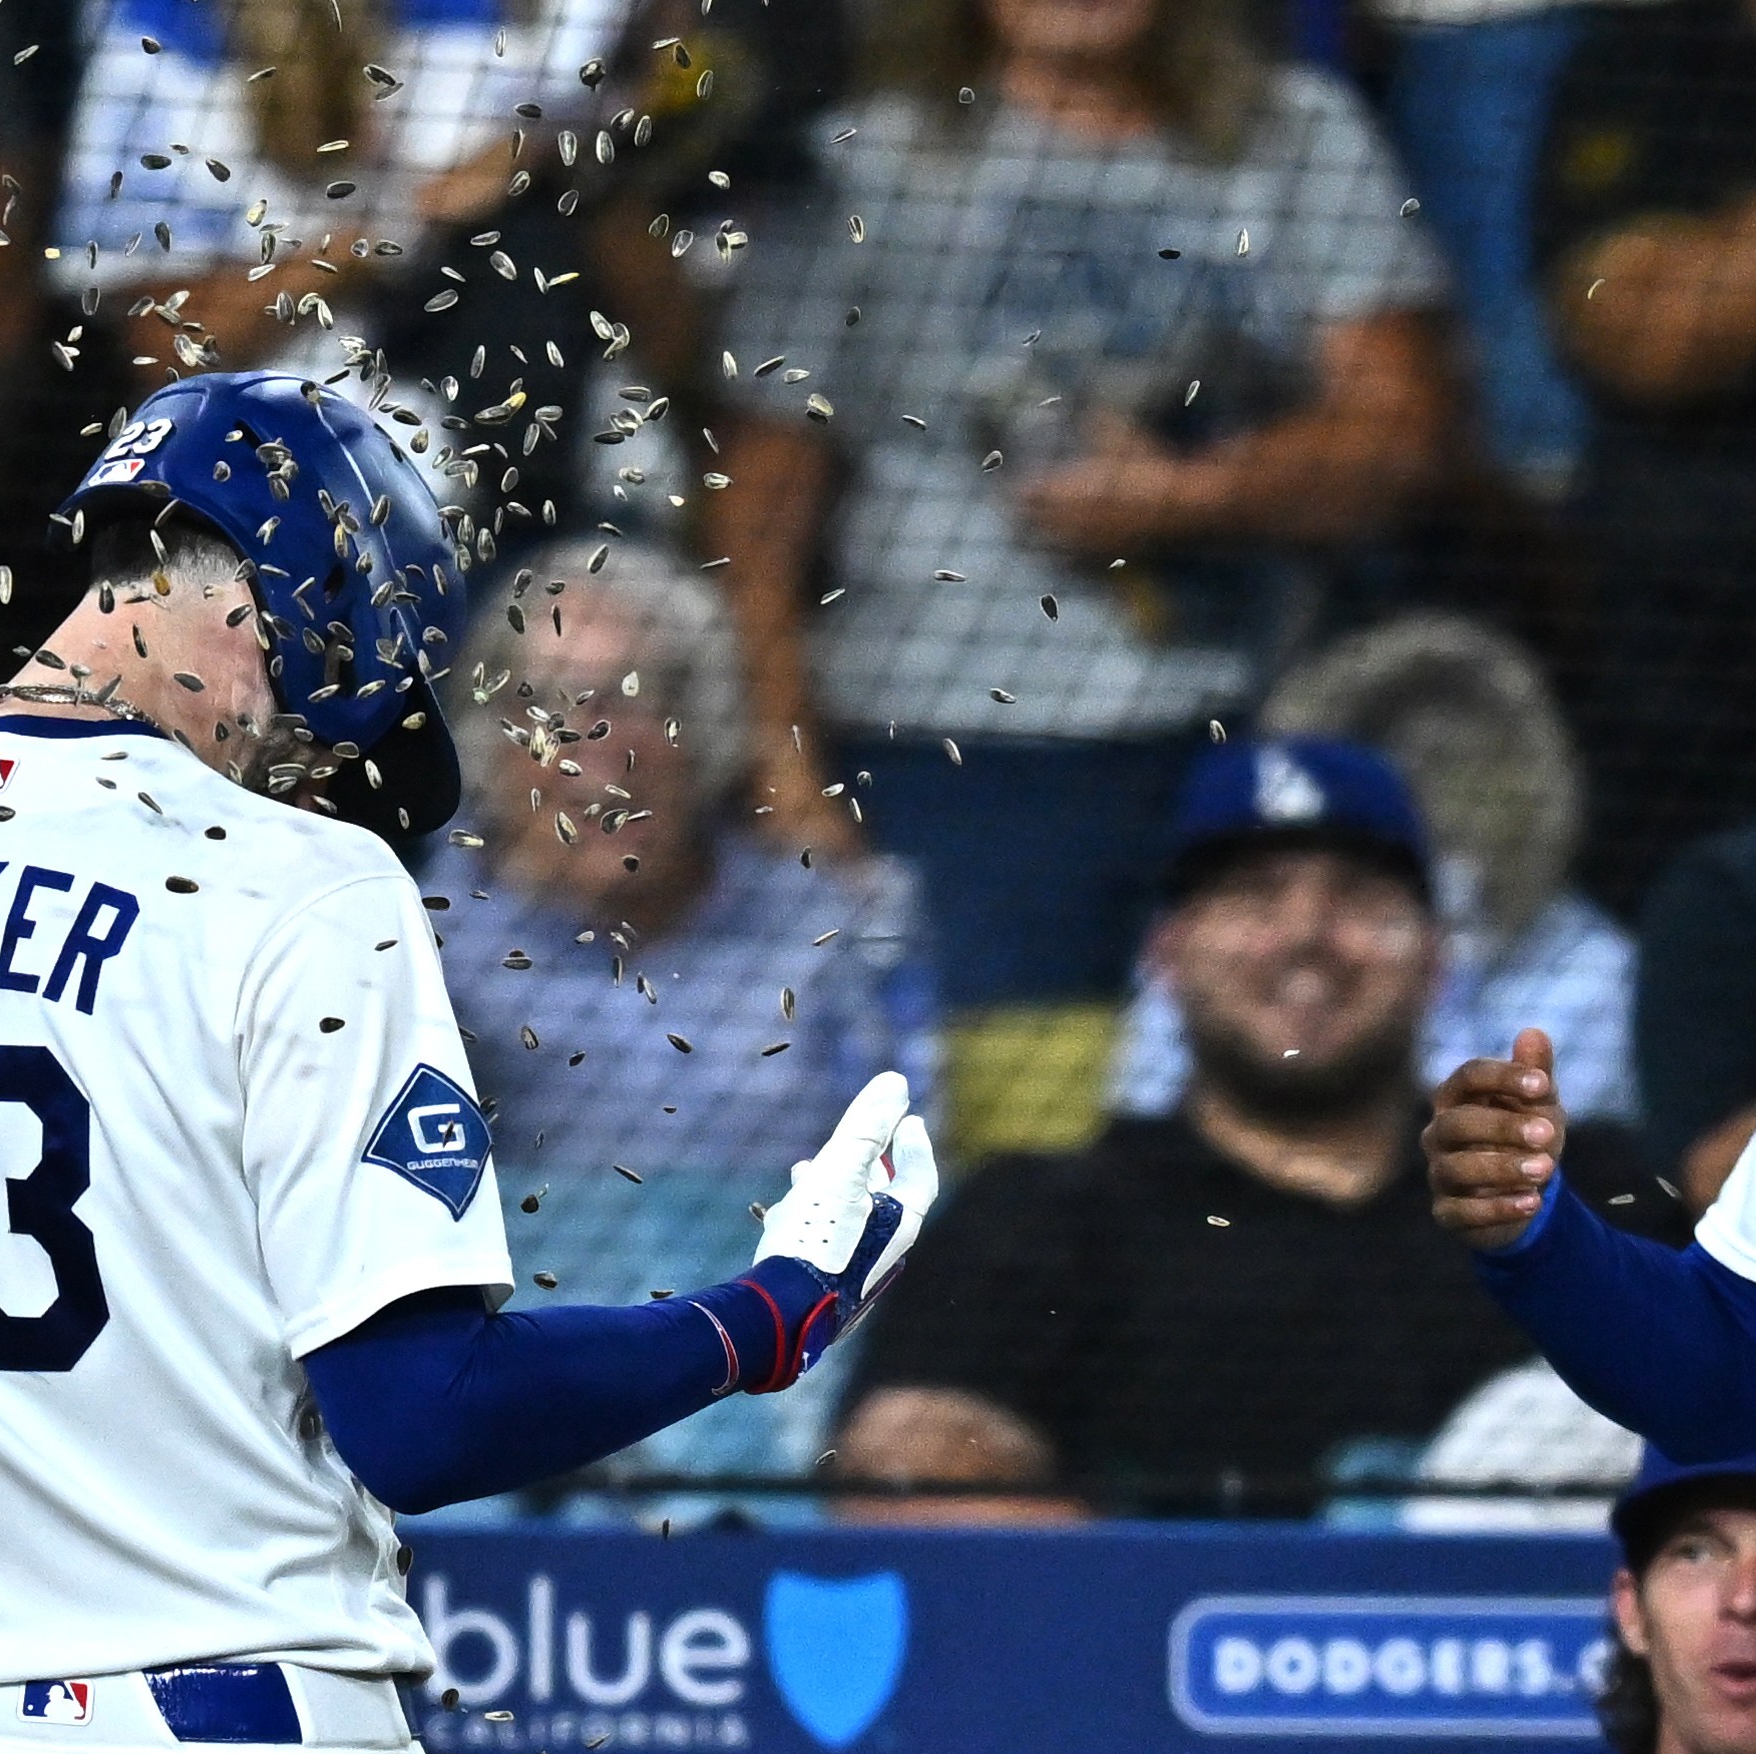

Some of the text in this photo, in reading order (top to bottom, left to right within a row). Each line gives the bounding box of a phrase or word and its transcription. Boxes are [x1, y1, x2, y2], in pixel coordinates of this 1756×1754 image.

[104, 418, 173, 460] 23
[407, 1103, 466, 1154] G
[425, 1572, 751, 1704] blue
[425, 1712, 751, 1750] CALIFORNIA
